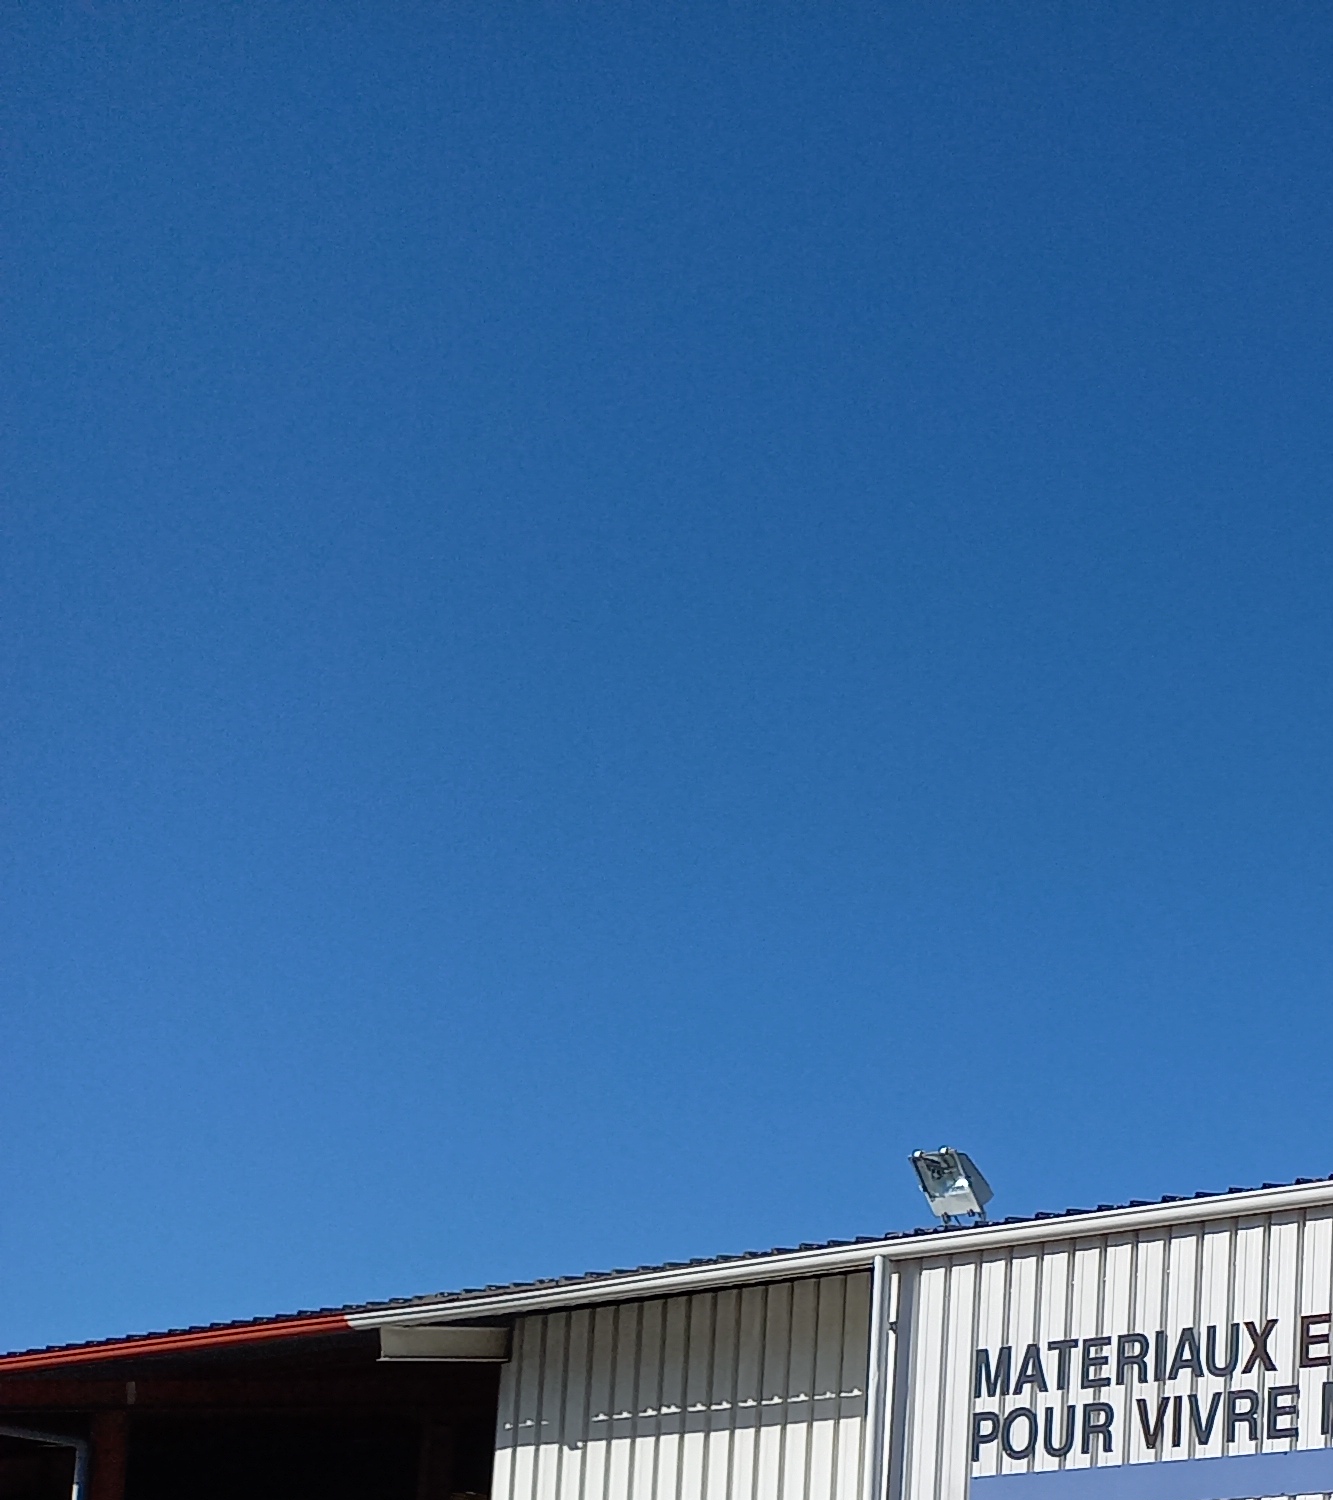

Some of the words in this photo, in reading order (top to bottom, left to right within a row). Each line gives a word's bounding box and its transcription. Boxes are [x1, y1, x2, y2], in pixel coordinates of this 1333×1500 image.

[974, 1318, 1279, 1399] MATERIAUX
[971, 1401, 1114, 1463] POUR
[1136, 1384, 1300, 1450] VIVRE
